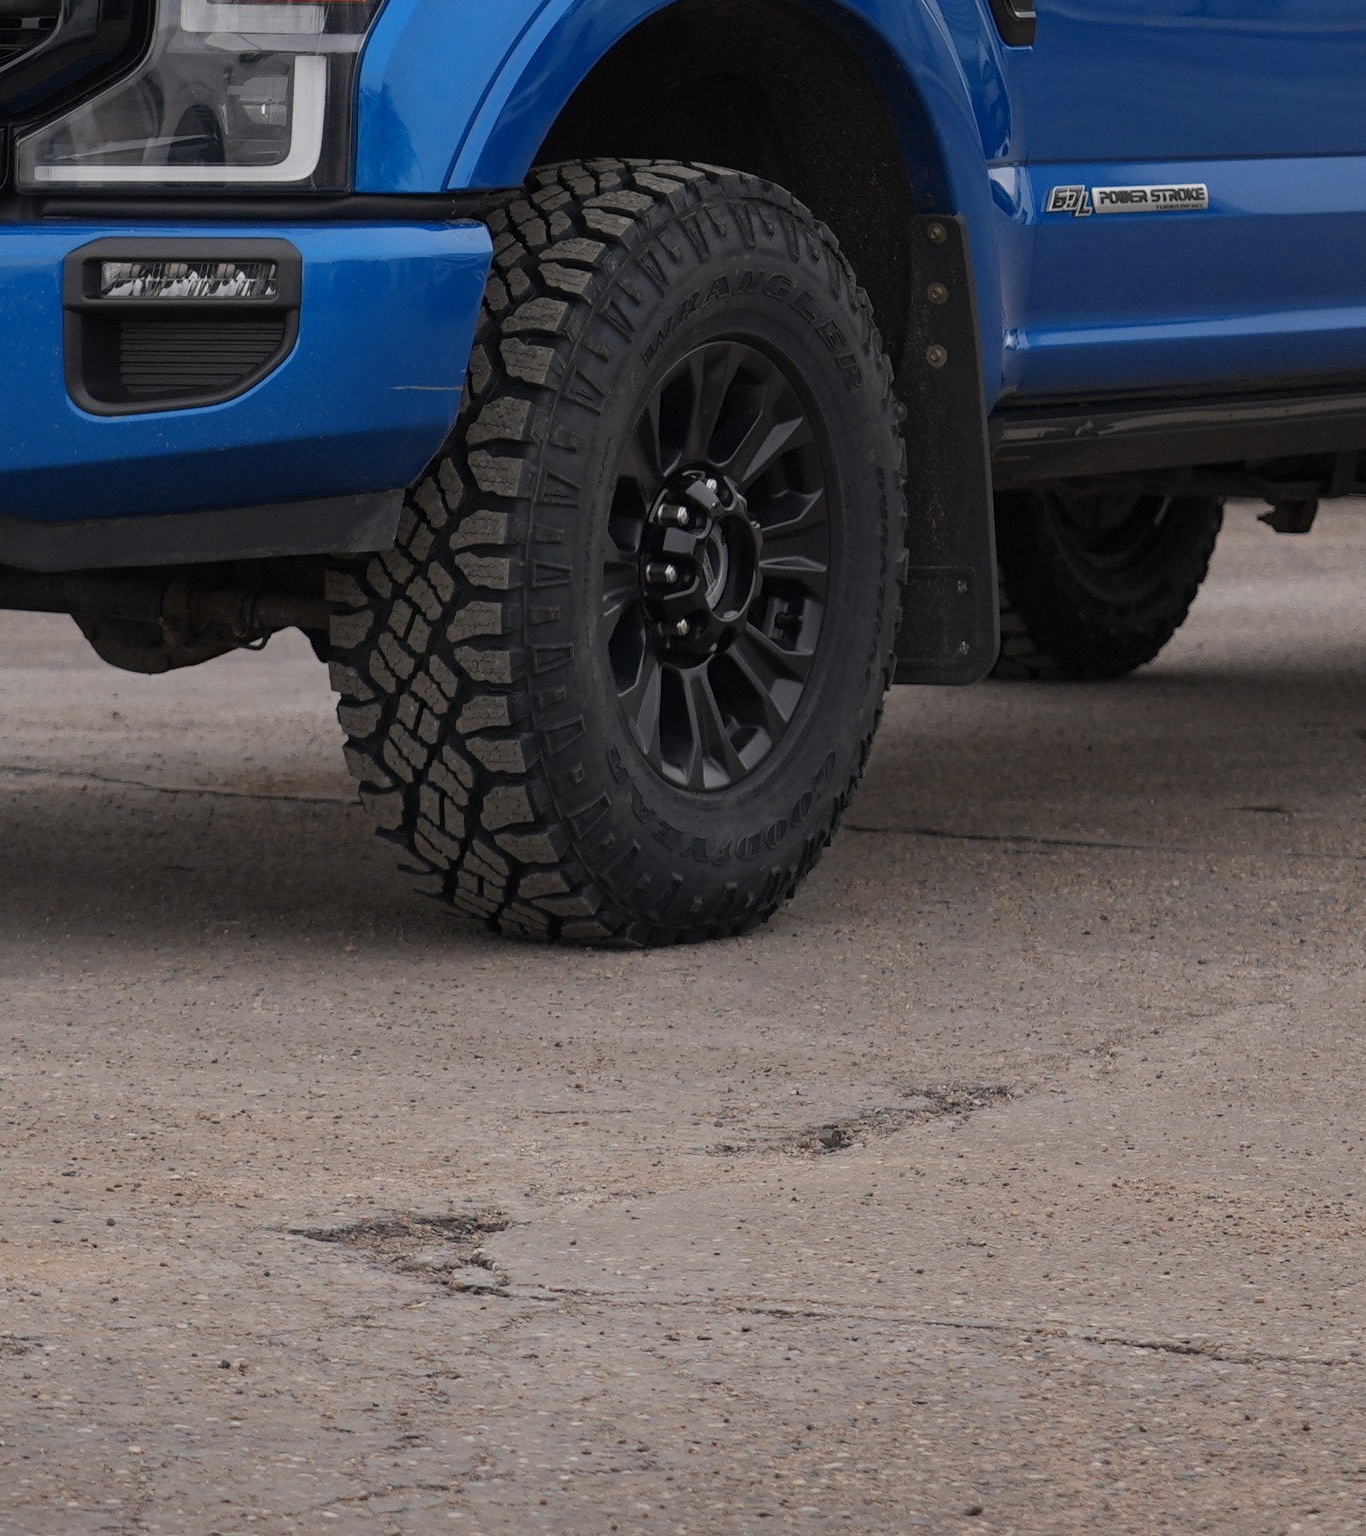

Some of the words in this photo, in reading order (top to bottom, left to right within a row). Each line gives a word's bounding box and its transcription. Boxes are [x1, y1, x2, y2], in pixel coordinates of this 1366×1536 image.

[1098, 189, 1149, 205] POWER
[1150, 187, 1206, 203] STROKE
[641, 270, 863, 392] WRANGLER
[605, 744, 836, 864] GOODYEAR
